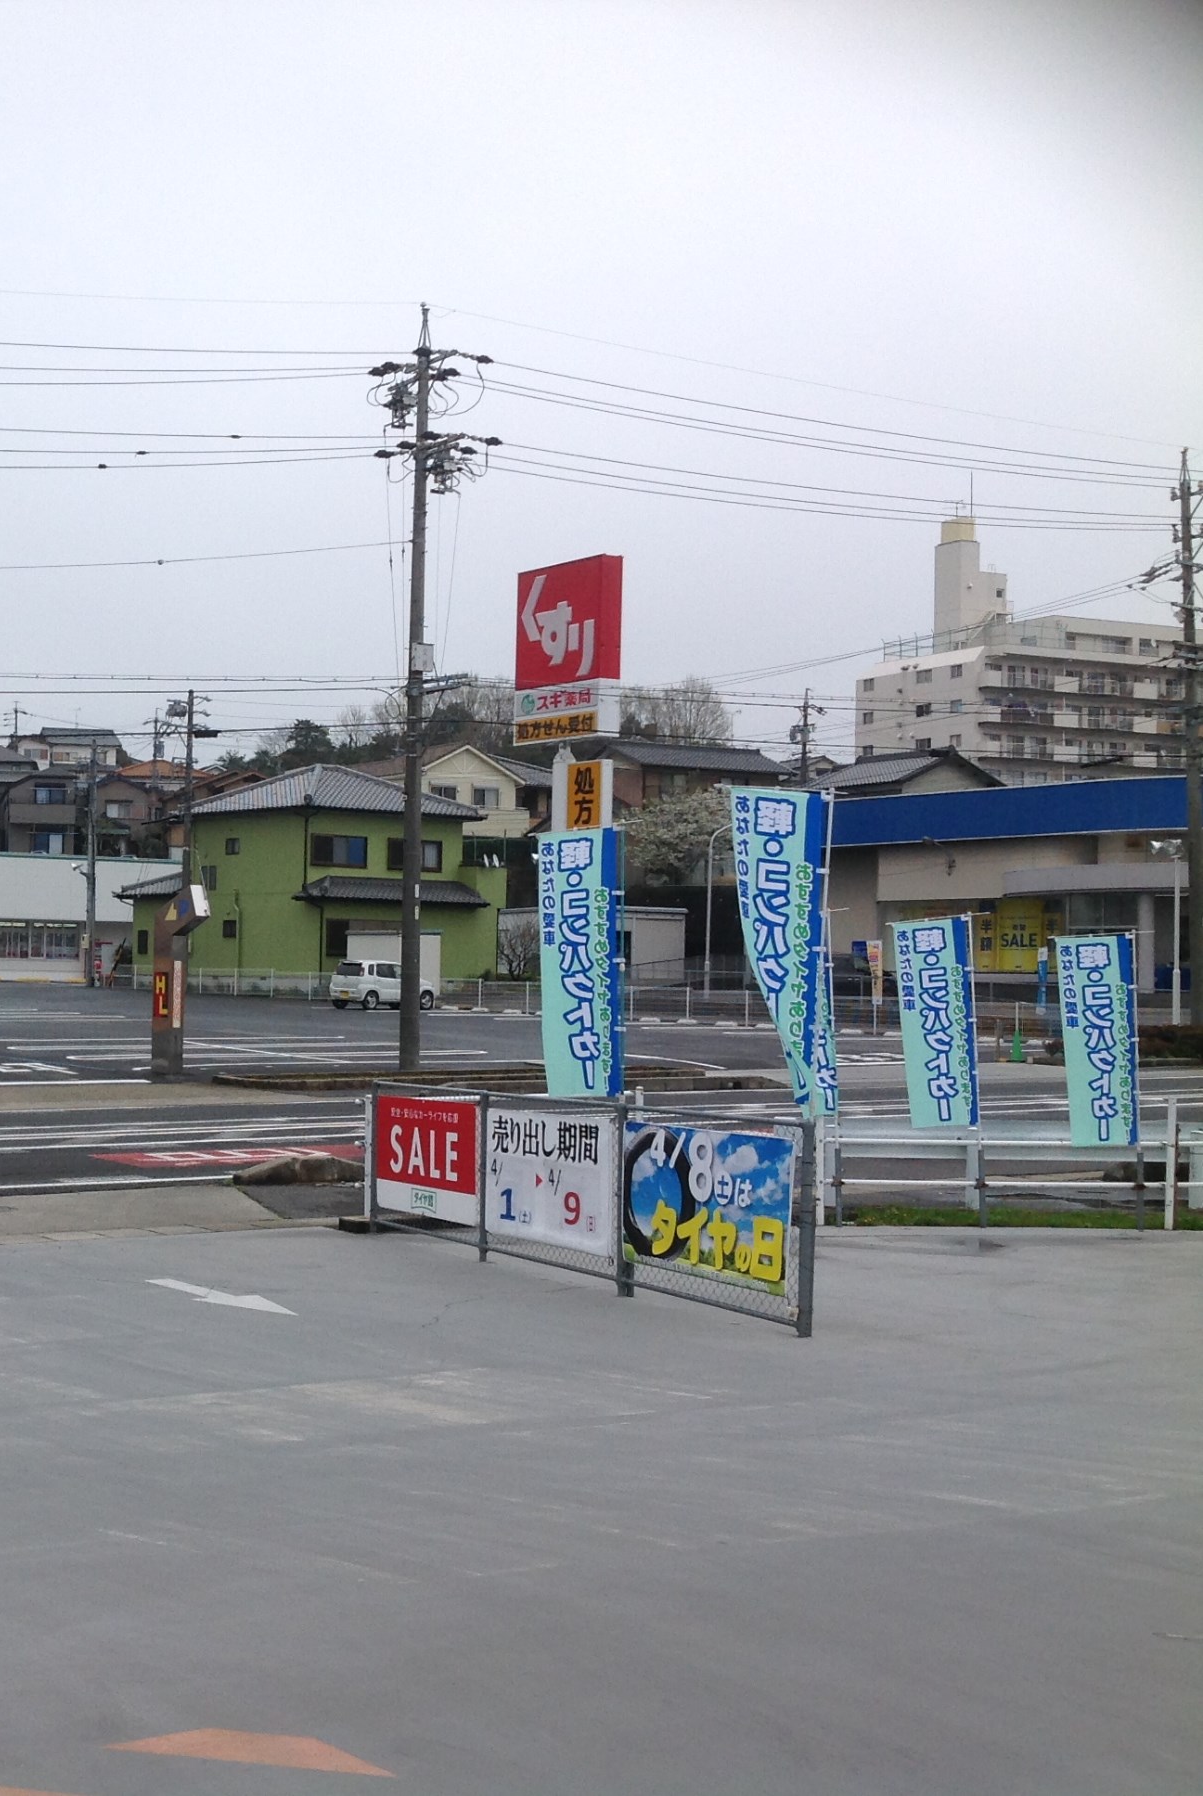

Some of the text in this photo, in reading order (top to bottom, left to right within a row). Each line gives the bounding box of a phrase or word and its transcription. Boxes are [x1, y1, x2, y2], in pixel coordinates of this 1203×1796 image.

[521, 574, 595, 677] くすり
[536, 688, 591, 711] スギ薬局
[517, 714, 594, 740] 処方せん受付
[1001, 933, 1037, 948] SALE
[390, 1124, 458, 1182] SALE
[492, 1115, 599, 1165] 売り出し期間
[651, 1199, 783, 1282] タイヤの日
